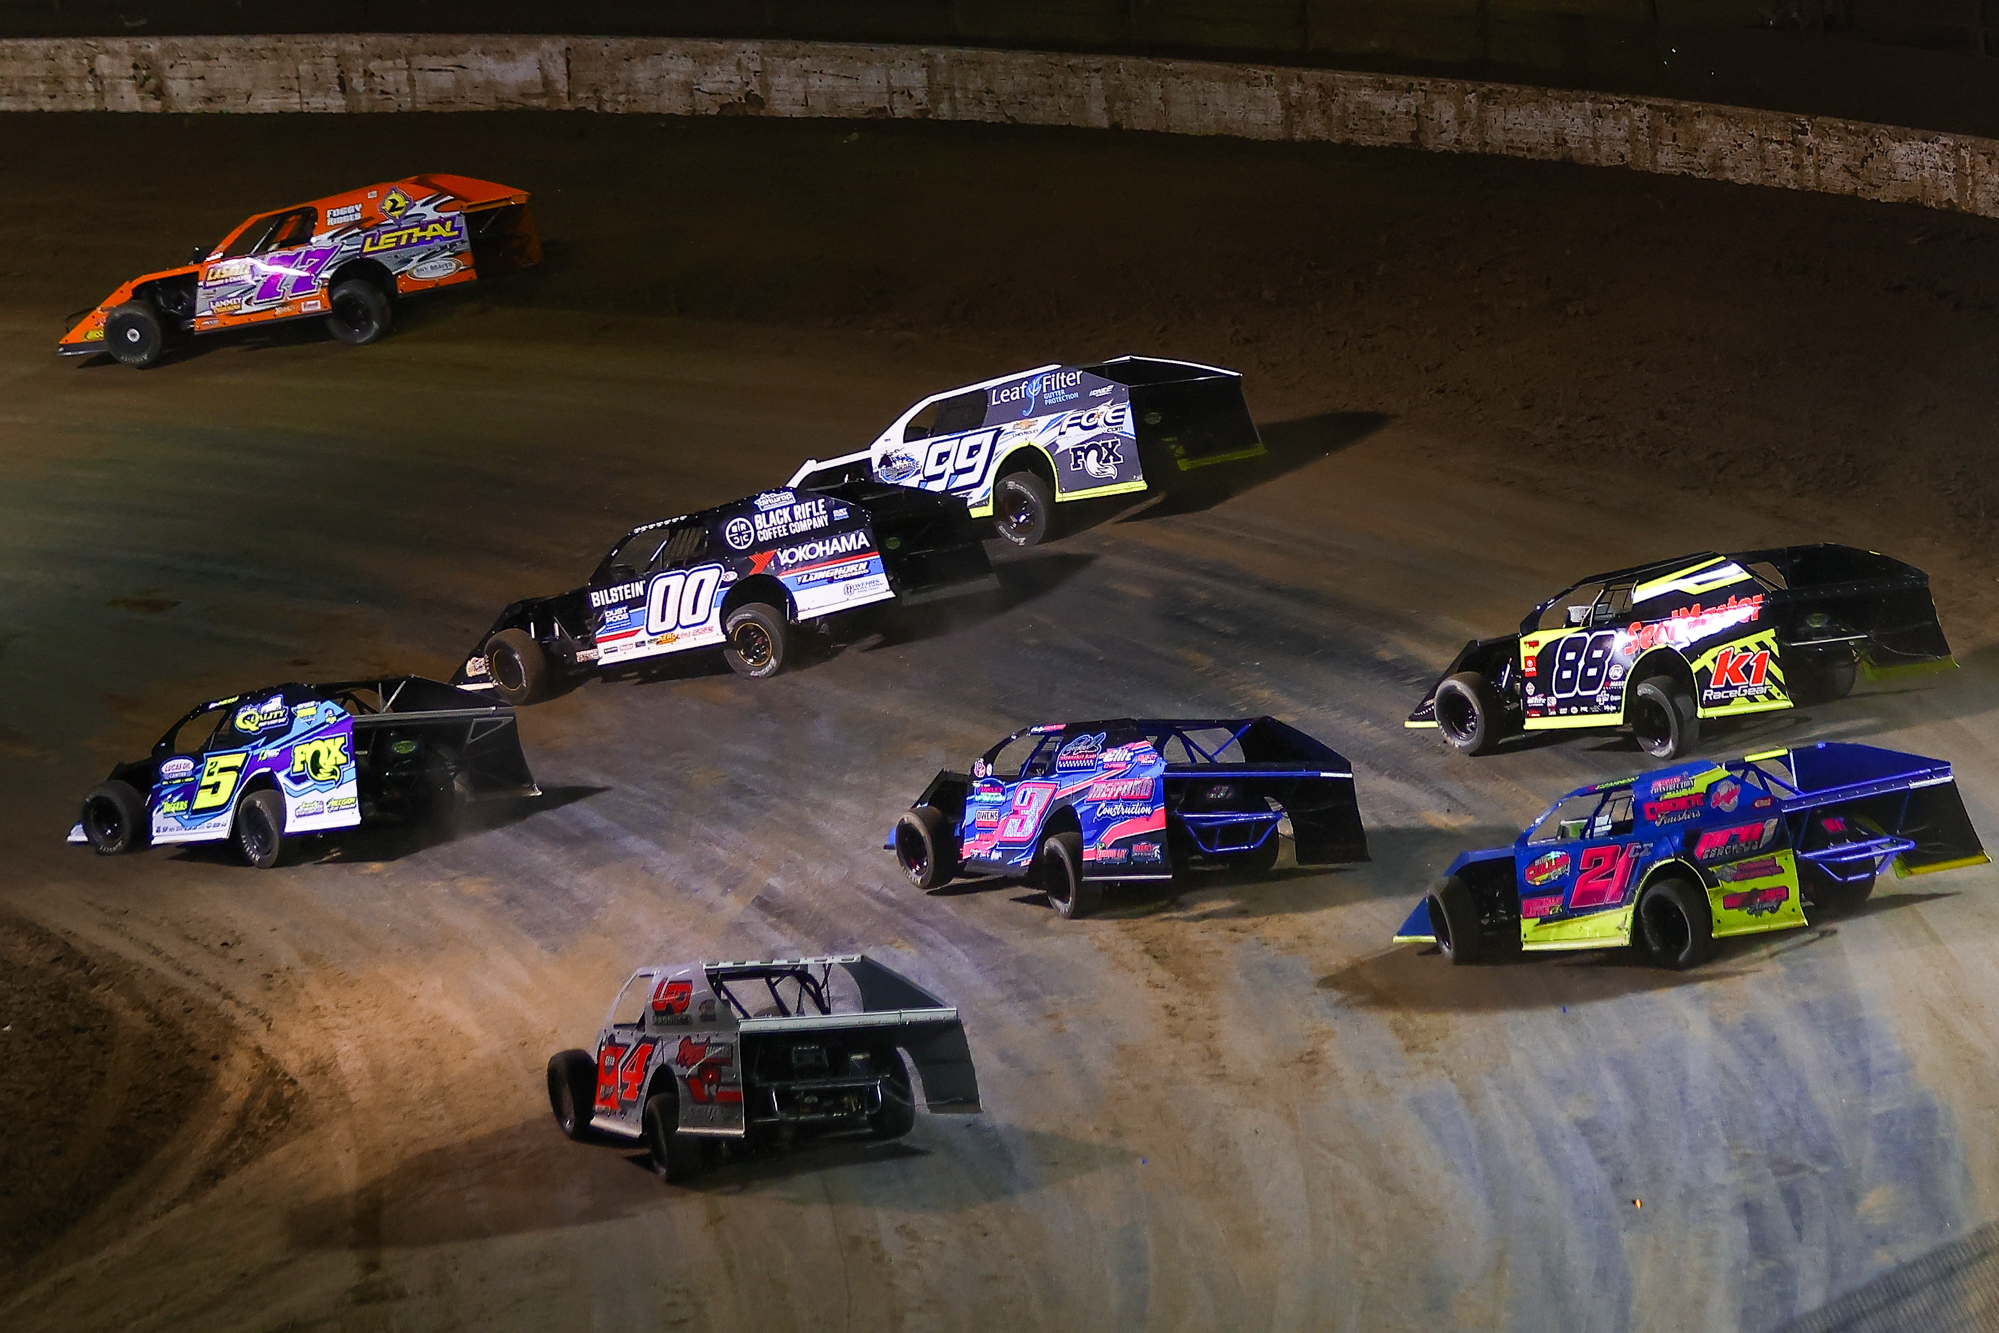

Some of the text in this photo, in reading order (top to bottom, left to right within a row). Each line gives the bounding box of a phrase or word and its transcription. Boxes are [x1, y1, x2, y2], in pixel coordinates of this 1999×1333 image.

[363, 221, 459, 253] LETHAL
[255, 245, 341, 301] 77
[991, 380, 1029, 406] Leaf
[1042, 370, 1084, 393] Filter
[1043, 389, 1066, 400] GUTTER
[1044, 392, 1079, 406] PROTECTION
[923, 428, 1001, 492] 99
[1070, 438, 1124, 479] FOX
[754, 505, 792, 531] BLACK
[794, 499, 827, 521] RIFLE
[756, 524, 788, 543] COFFEE
[788, 514, 830, 535] COMPANY
[776, 531, 871, 567] YOKOHAMA
[590, 580, 646, 608] BILSTEIN
[647, 565, 723, 635] 00
[604, 606, 628, 617] DUST
[606, 613, 629, 624] PODS
[1553, 630, 1616, 698] 88
[1710, 647, 1770, 688] K1
[1703, 685, 1772, 701] RaceGear
[164, 762, 182, 773] LUCAS
[292, 736, 348, 781] FOX
[1103, 748, 1134, 762] Elite
[976, 810, 999, 821] OWENS
[1096, 802, 1153, 818] Construction
